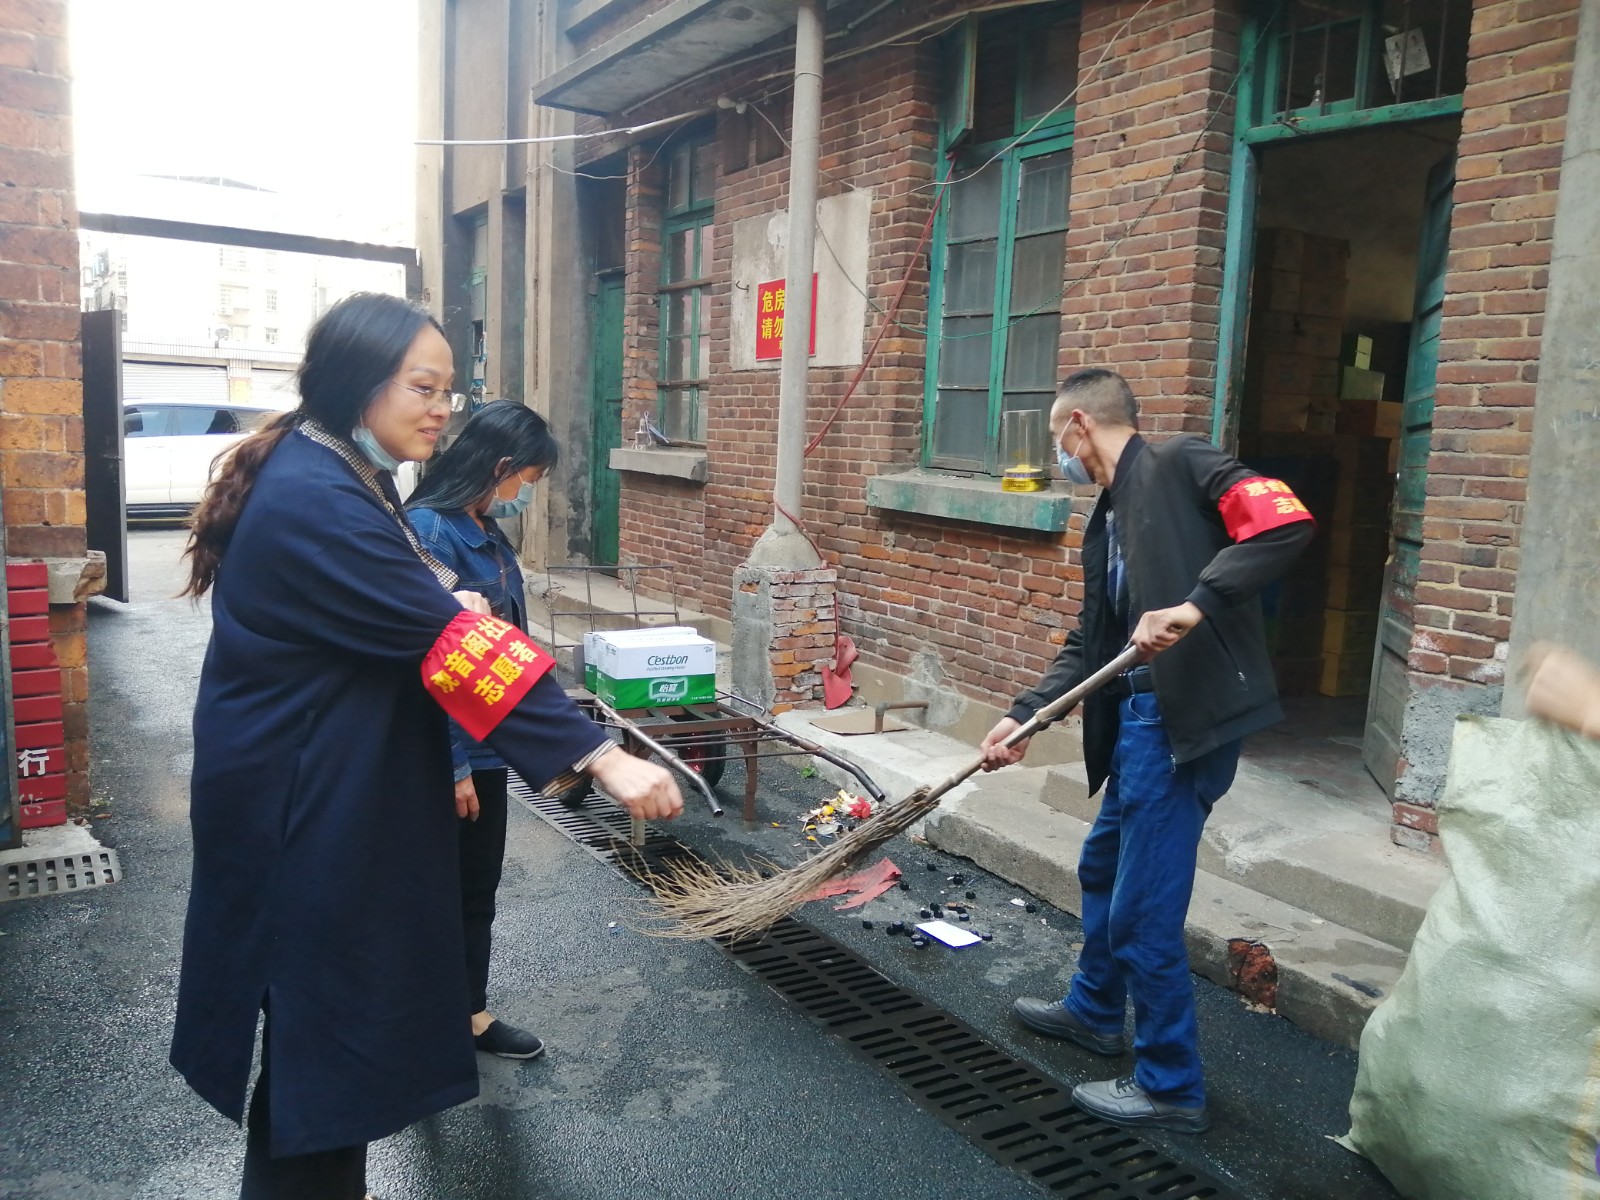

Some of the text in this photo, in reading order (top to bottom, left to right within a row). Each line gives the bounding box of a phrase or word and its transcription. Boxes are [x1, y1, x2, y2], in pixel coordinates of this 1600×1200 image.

[762, 288, 784, 313] 危房
[761, 316, 783, 339] 请勿
[473, 640, 538, 705] 志愿者
[18, 749, 49, 776] 行
